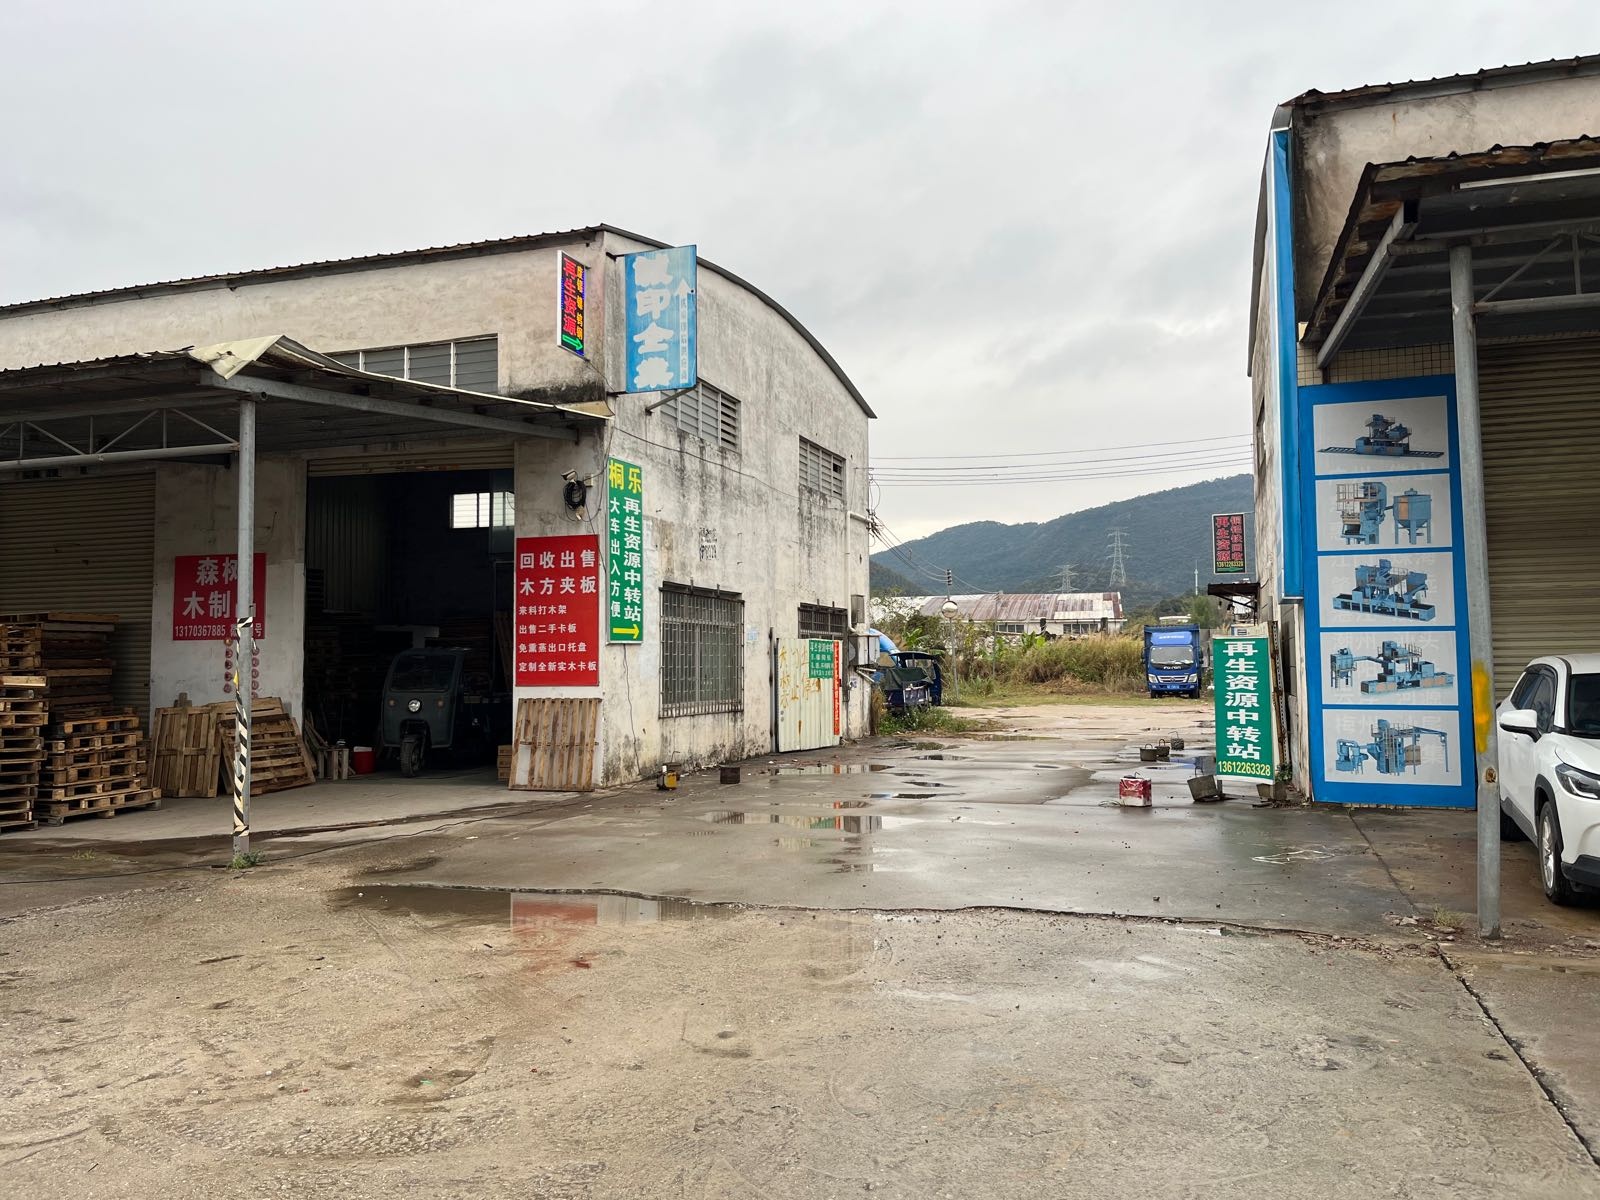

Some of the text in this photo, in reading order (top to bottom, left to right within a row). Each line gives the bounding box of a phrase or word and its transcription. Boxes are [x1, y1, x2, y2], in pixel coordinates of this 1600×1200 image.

[609, 460, 642, 494] 桐乐
[520, 549, 596, 569] 回收出售
[609, 497, 621, 618] 大车出入方便
[623, 497, 642, 622] 再生资源中转站
[520, 576, 597, 596] 木方夹板
[518, 605, 568, 616] 来料打木架
[175, 625, 226, 638] 13170367885
[519, 623, 577, 634] 出售二手卡板
[518, 661, 597, 672] 定制全新实木卡板
[1223, 641, 1261, 760] 再生资源中转站
[1218, 761, 1271, 776] 13612263328
